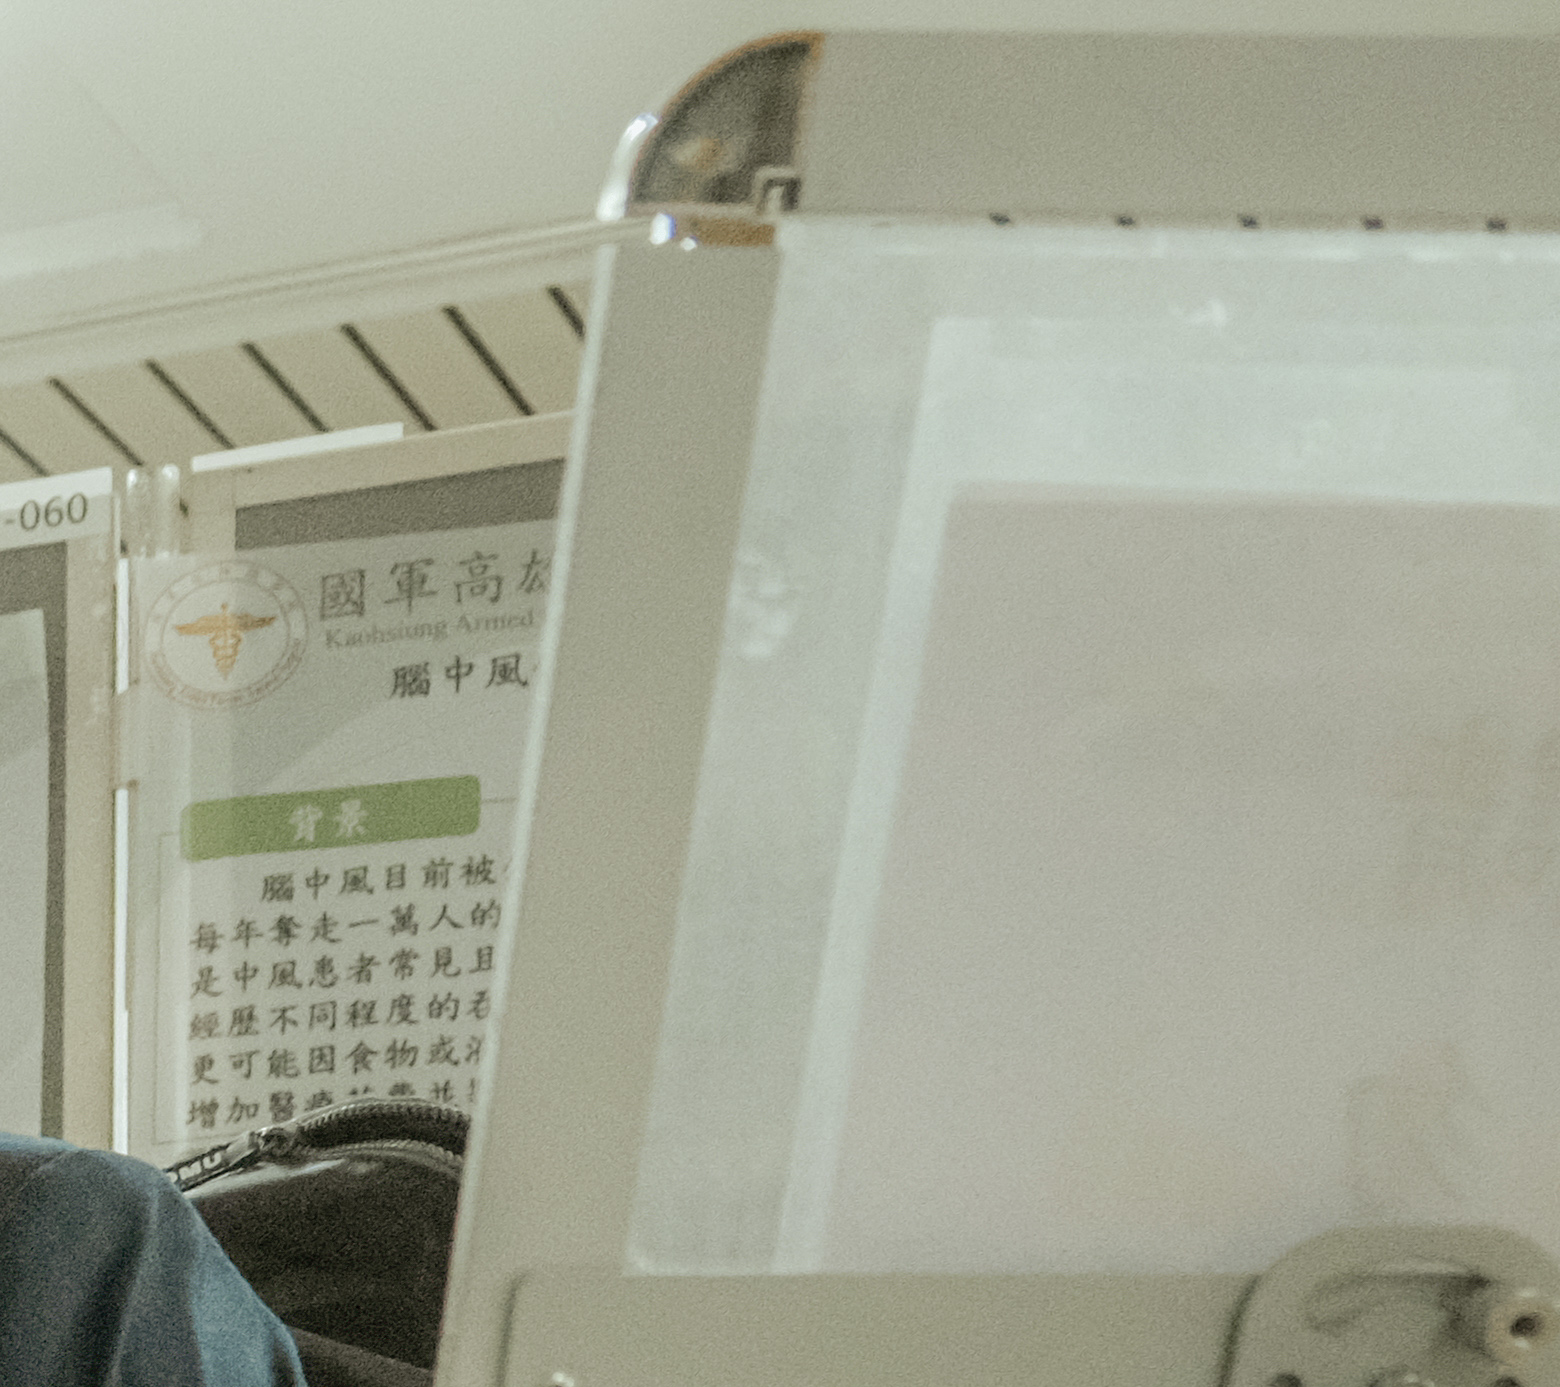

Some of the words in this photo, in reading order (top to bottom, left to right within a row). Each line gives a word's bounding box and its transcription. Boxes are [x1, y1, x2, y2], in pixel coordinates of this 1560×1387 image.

[324, 620, 449, 651] Kaohsiung
[453, 609, 534, 635] Armed
[389, 652, 528, 699] 腦中風
[288, 801, 366, 843] 背景
[260, 854, 497, 903] 腦中風目前被
[191, 899, 501, 955] 每年奪走一萬人的
